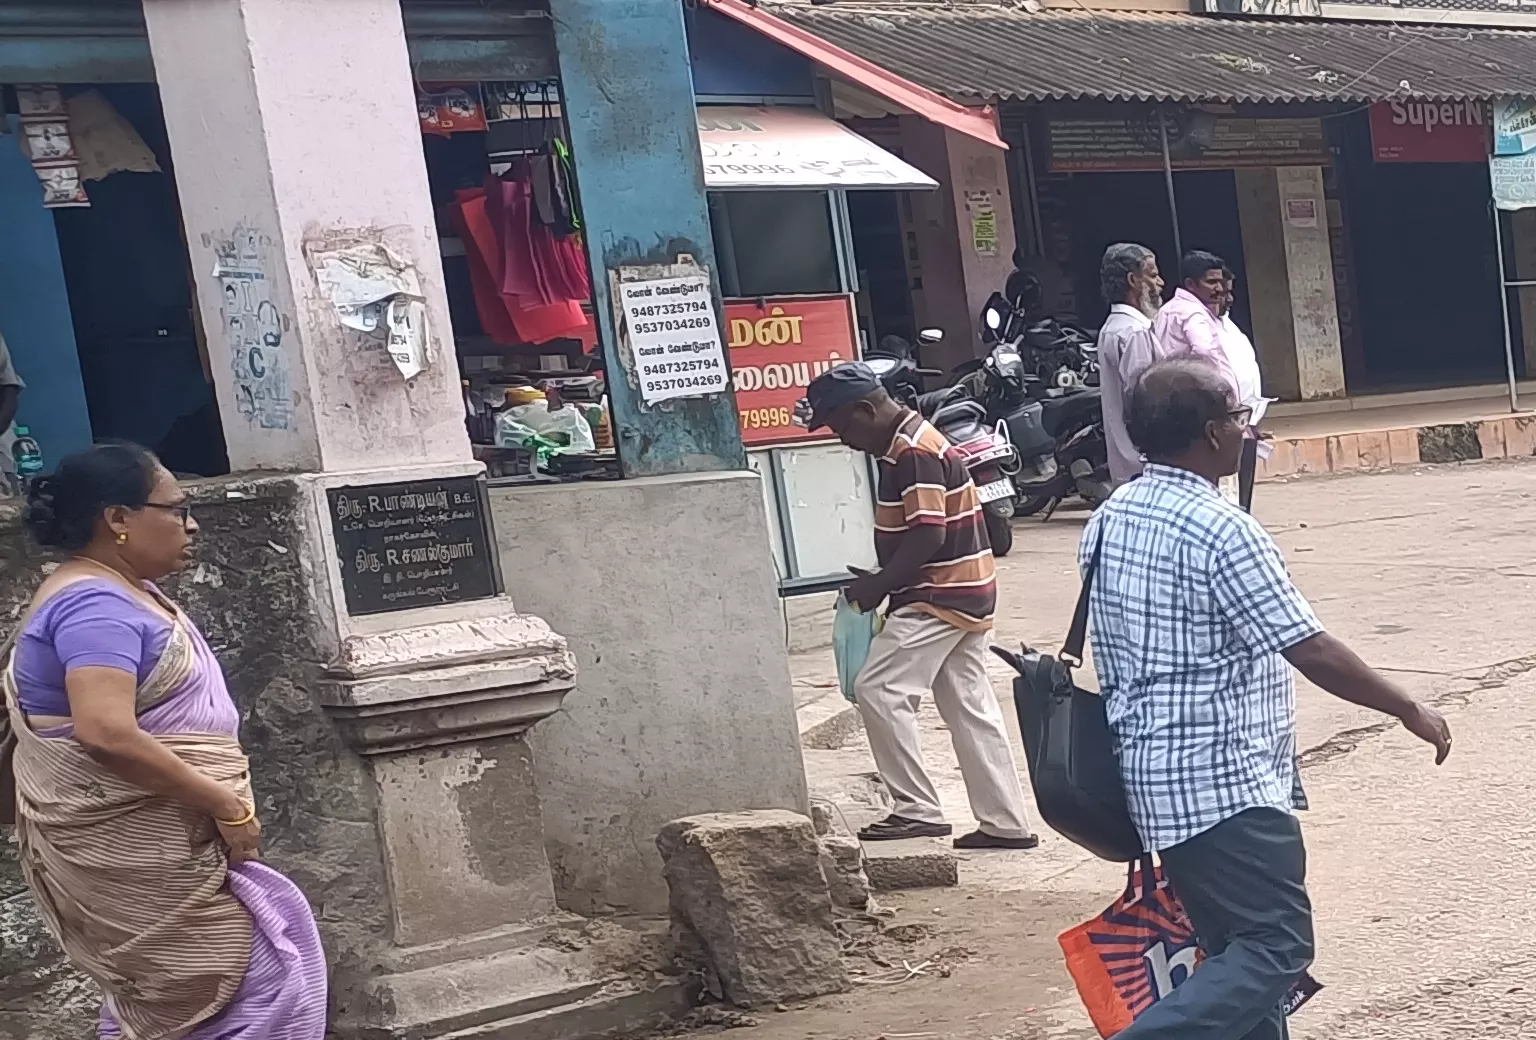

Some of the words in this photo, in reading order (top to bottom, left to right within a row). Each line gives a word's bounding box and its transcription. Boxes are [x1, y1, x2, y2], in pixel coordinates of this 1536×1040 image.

[631, 301, 708, 318] 9487325794
[634, 316, 711, 334] 9537034269
[643, 358, 719, 376] 9487325794
[646, 374, 722, 392] 9537034269
